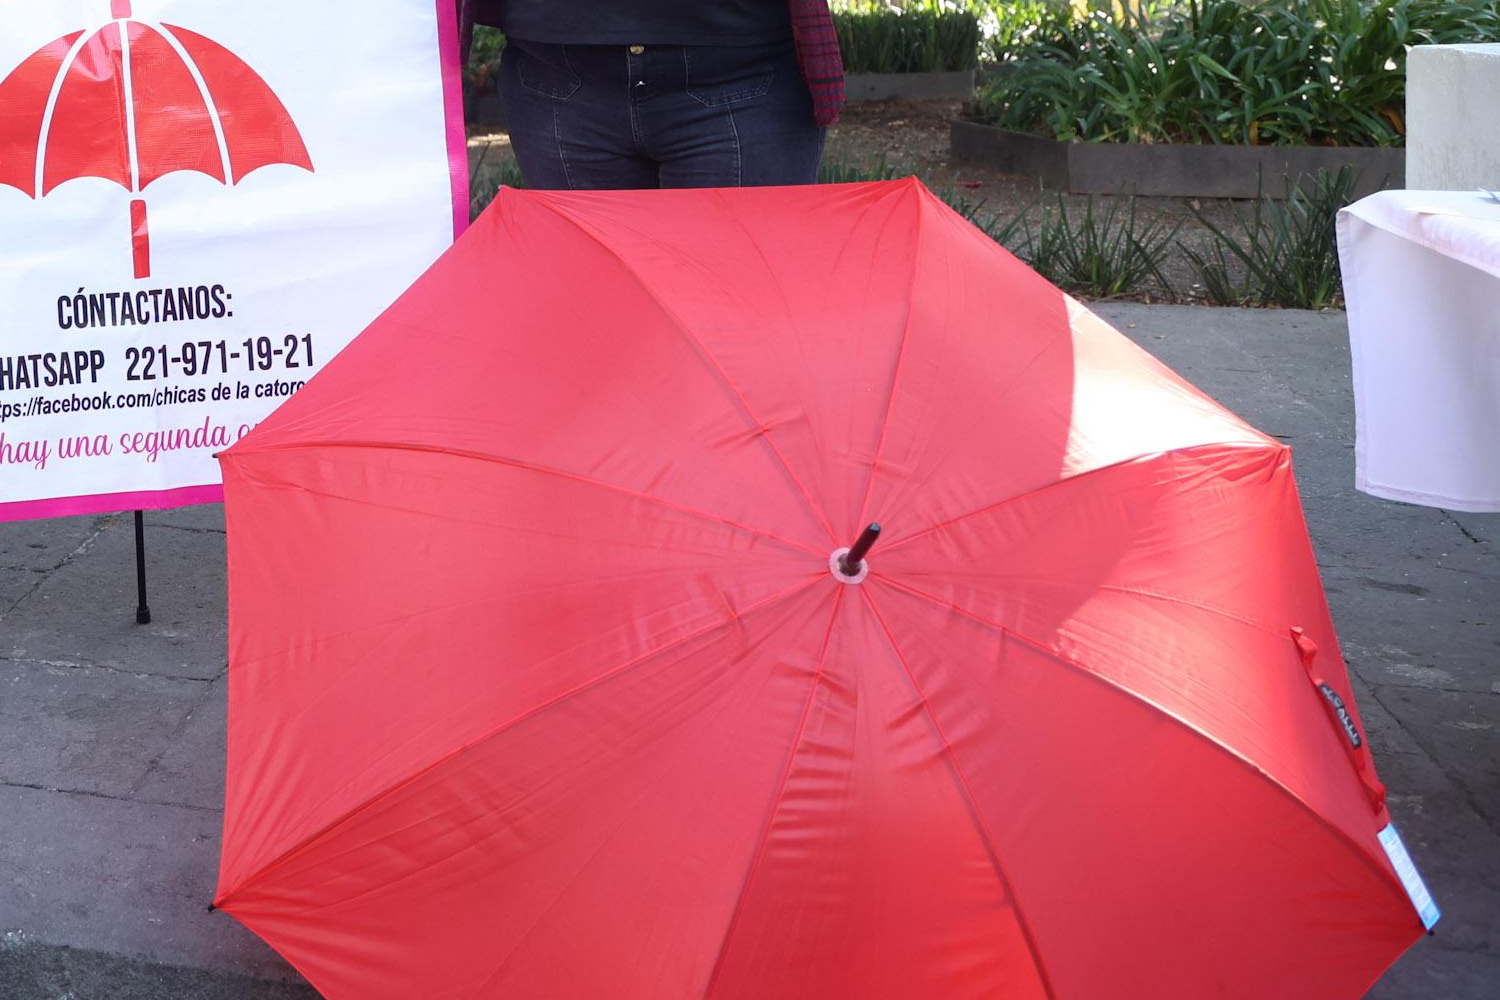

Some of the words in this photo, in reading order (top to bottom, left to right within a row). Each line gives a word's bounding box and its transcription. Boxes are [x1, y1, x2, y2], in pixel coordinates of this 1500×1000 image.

[57, 284, 233, 330] CÓNTACTANOS:
[125, 333, 313, 381] 221-971-19-21
[211, 382, 231, 401] de
[236, 381, 250, 400] la
[57, 433, 113, 459] una
[119, 415, 231, 463] segunda
